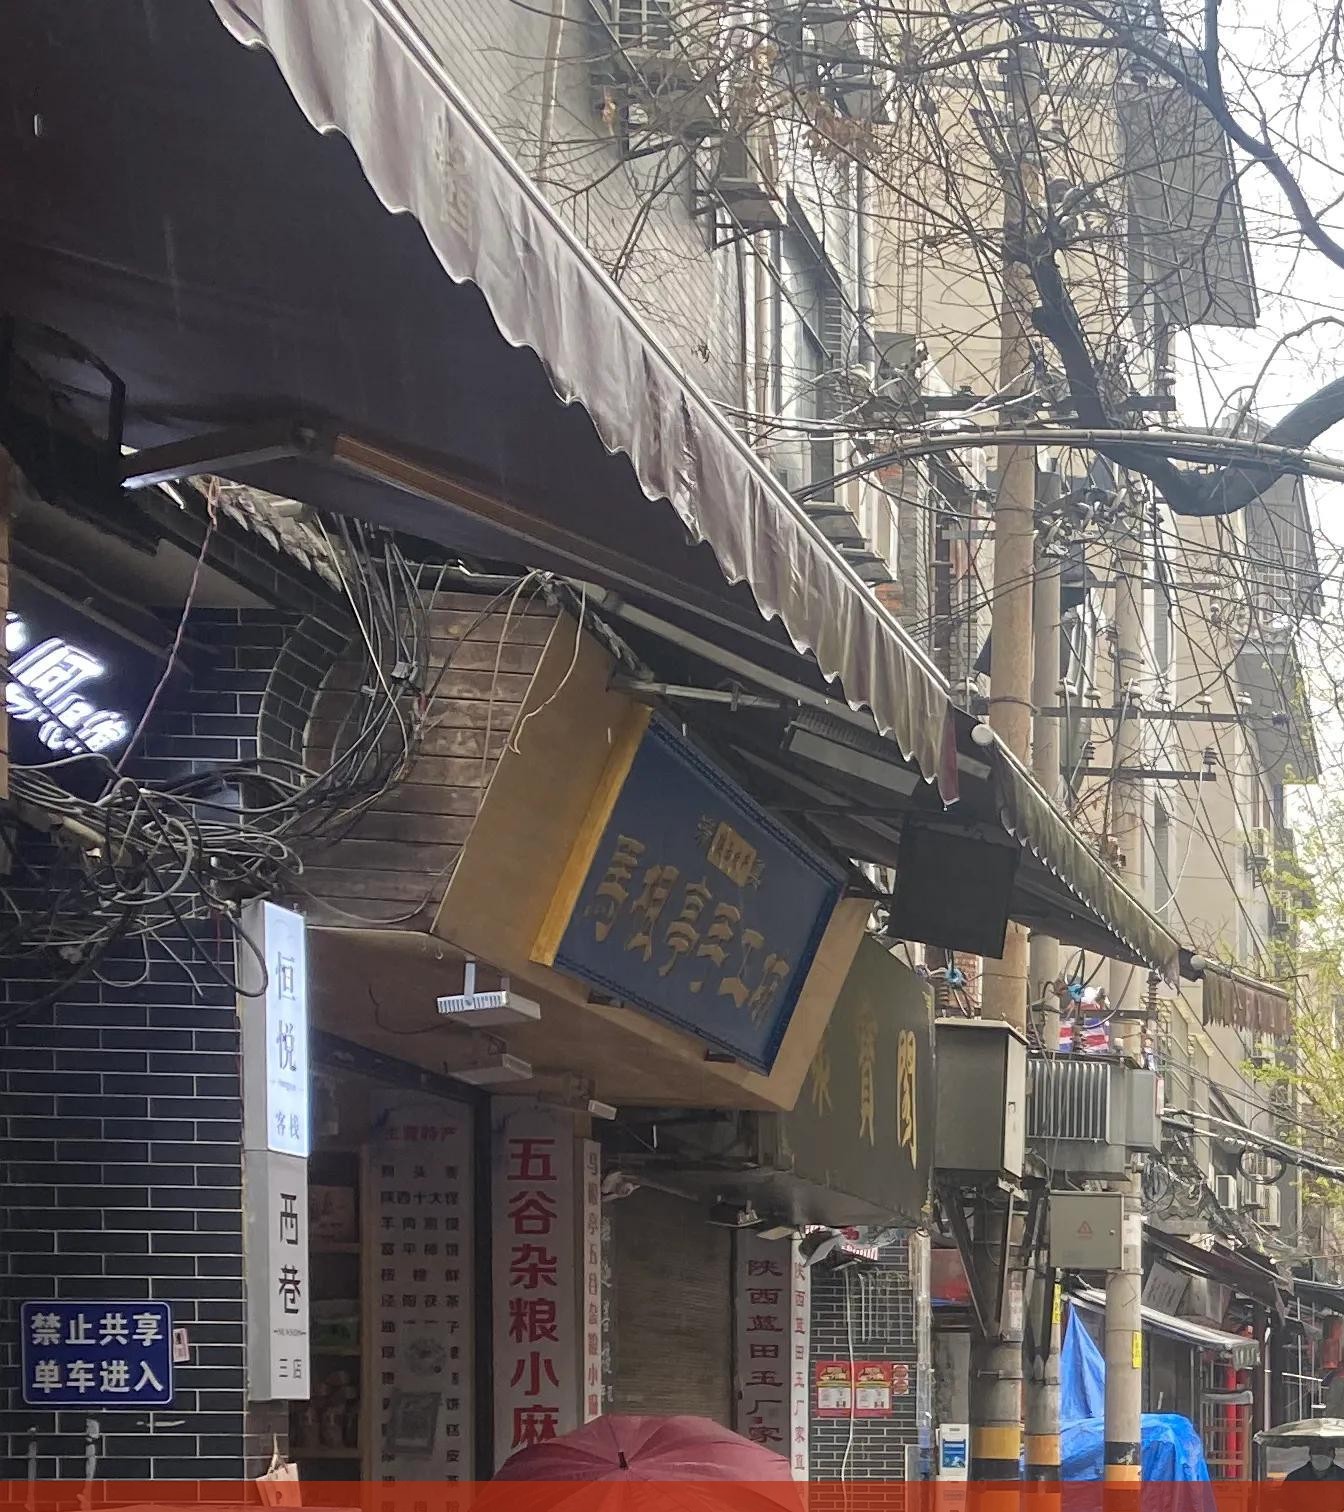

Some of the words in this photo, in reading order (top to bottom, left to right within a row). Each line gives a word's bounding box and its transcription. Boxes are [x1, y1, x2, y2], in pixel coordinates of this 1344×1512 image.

[278, 1193, 301, 1313] 西巷
[30, 1312, 163, 1347] 禁止共享
[746, 1260, 784, 1442] 陕西蓝田玉厂家
[32, 1359, 163, 1394] 单车进入
